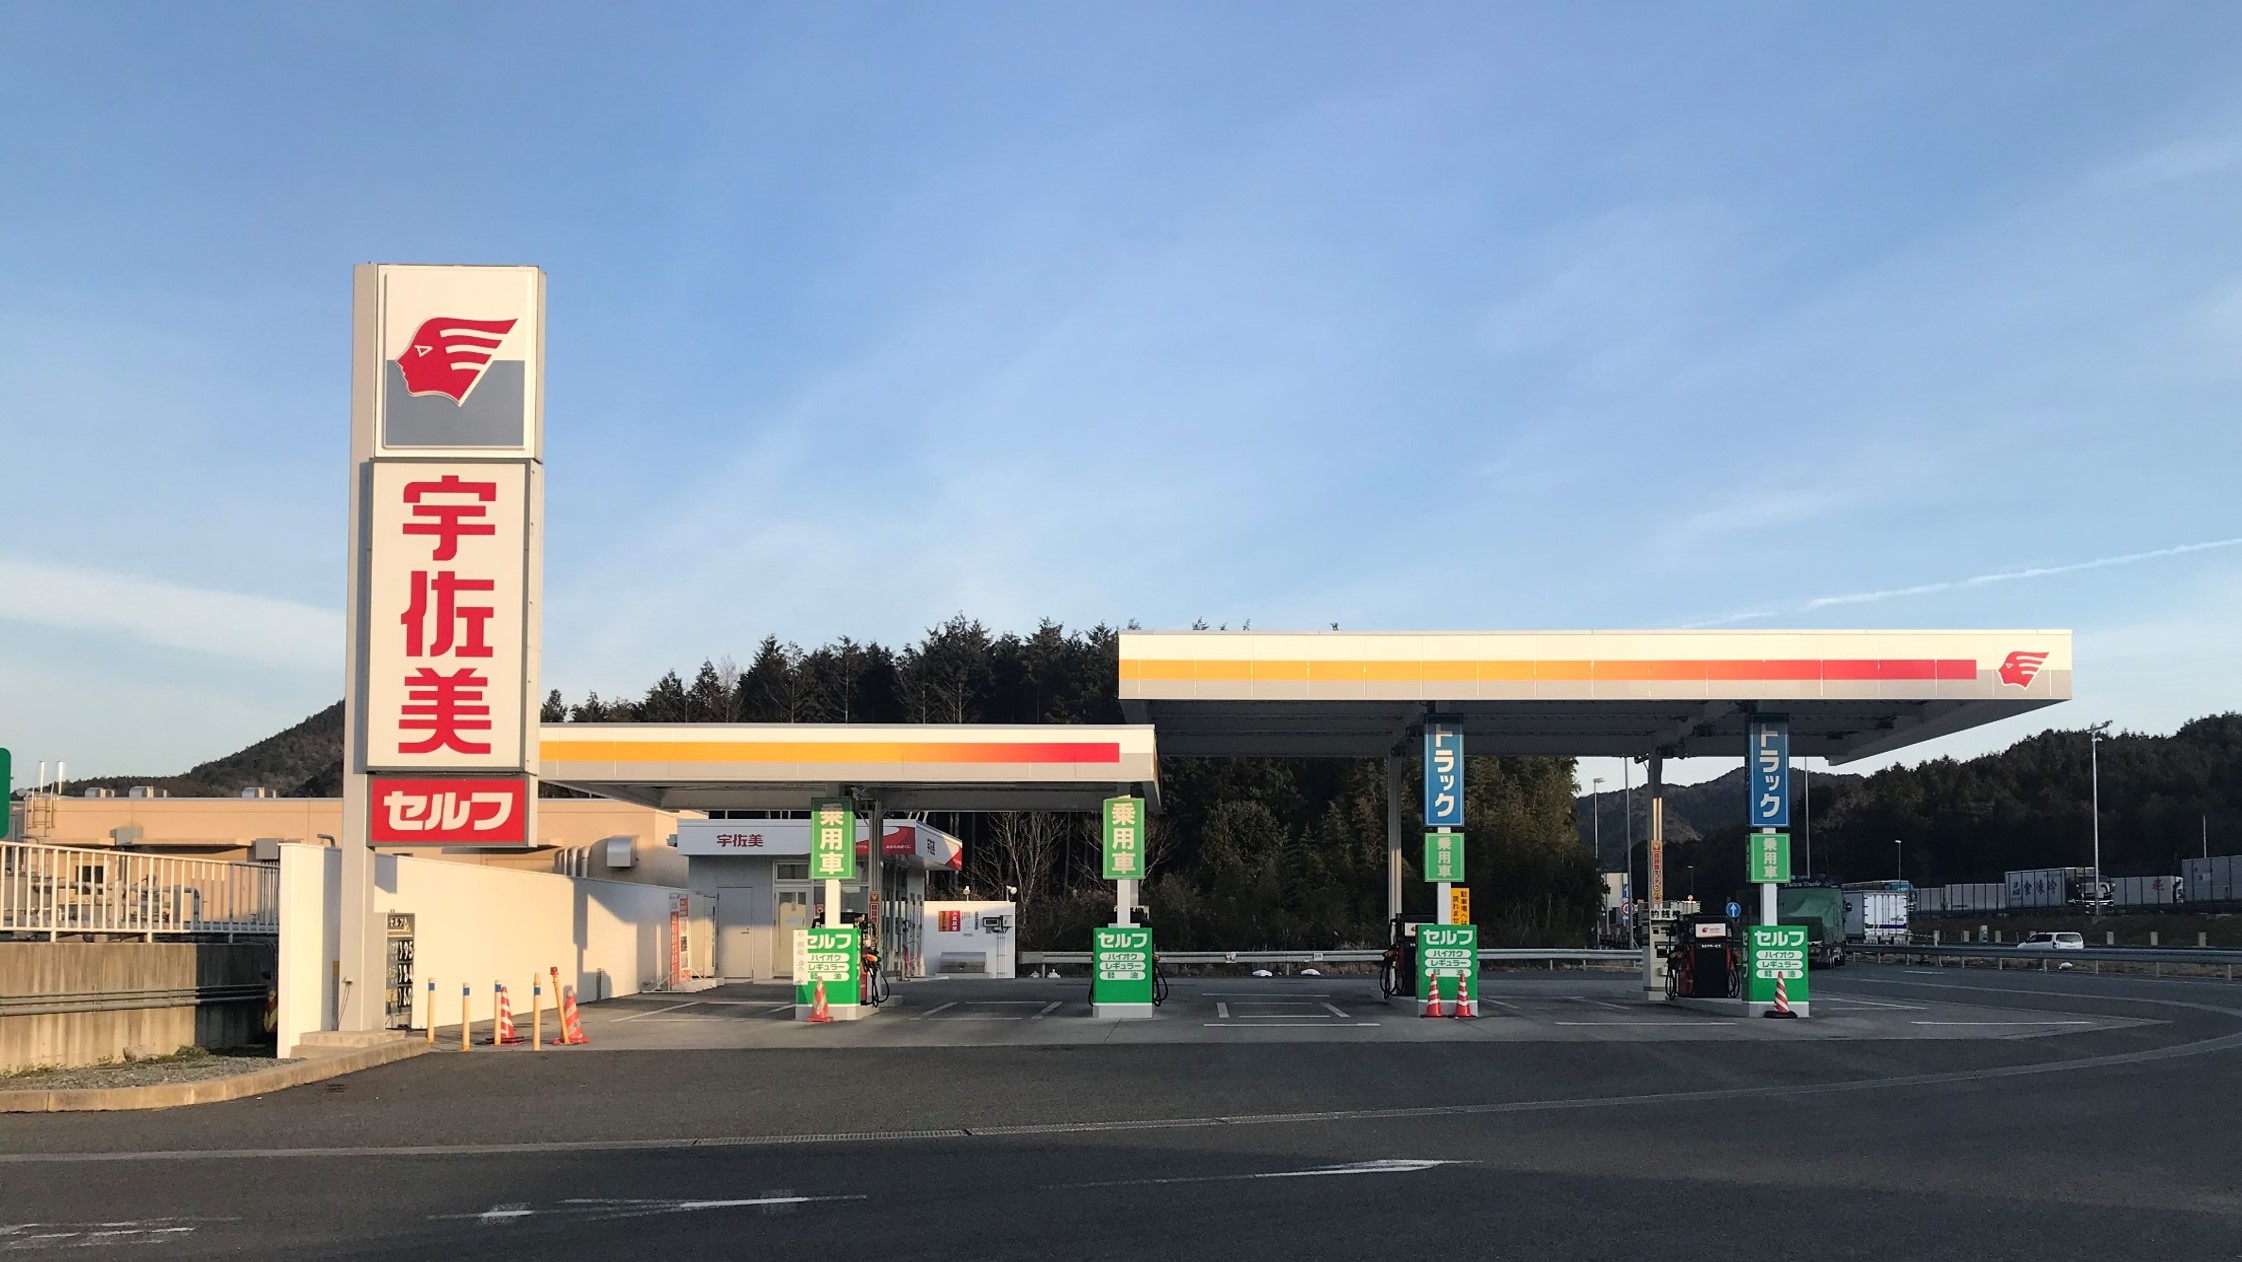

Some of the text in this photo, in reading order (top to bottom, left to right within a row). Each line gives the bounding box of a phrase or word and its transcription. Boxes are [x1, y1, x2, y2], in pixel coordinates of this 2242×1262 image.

[397, 474, 497, 755] 宇佐美
[1433, 723, 1455, 817] トラック
[1759, 722, 1780, 818] トラック
[383, 790, 513, 831] セルフ
[716, 833, 764, 848] 宇佐美
[819, 803, 844, 875] 乗用車
[1111, 802, 1136, 875] 乗用車
[1437, 837, 1452, 878] 乗用車
[1763, 837, 1778, 879] 乗用車
[808, 934, 852, 949] セルフ
[1097, 932, 1148, 949] セルフ
[1423, 929, 1473, 945] セルフ
[1754, 930, 1804, 947] セルフ
[1762, 960, 1799, 968] レギュラー
